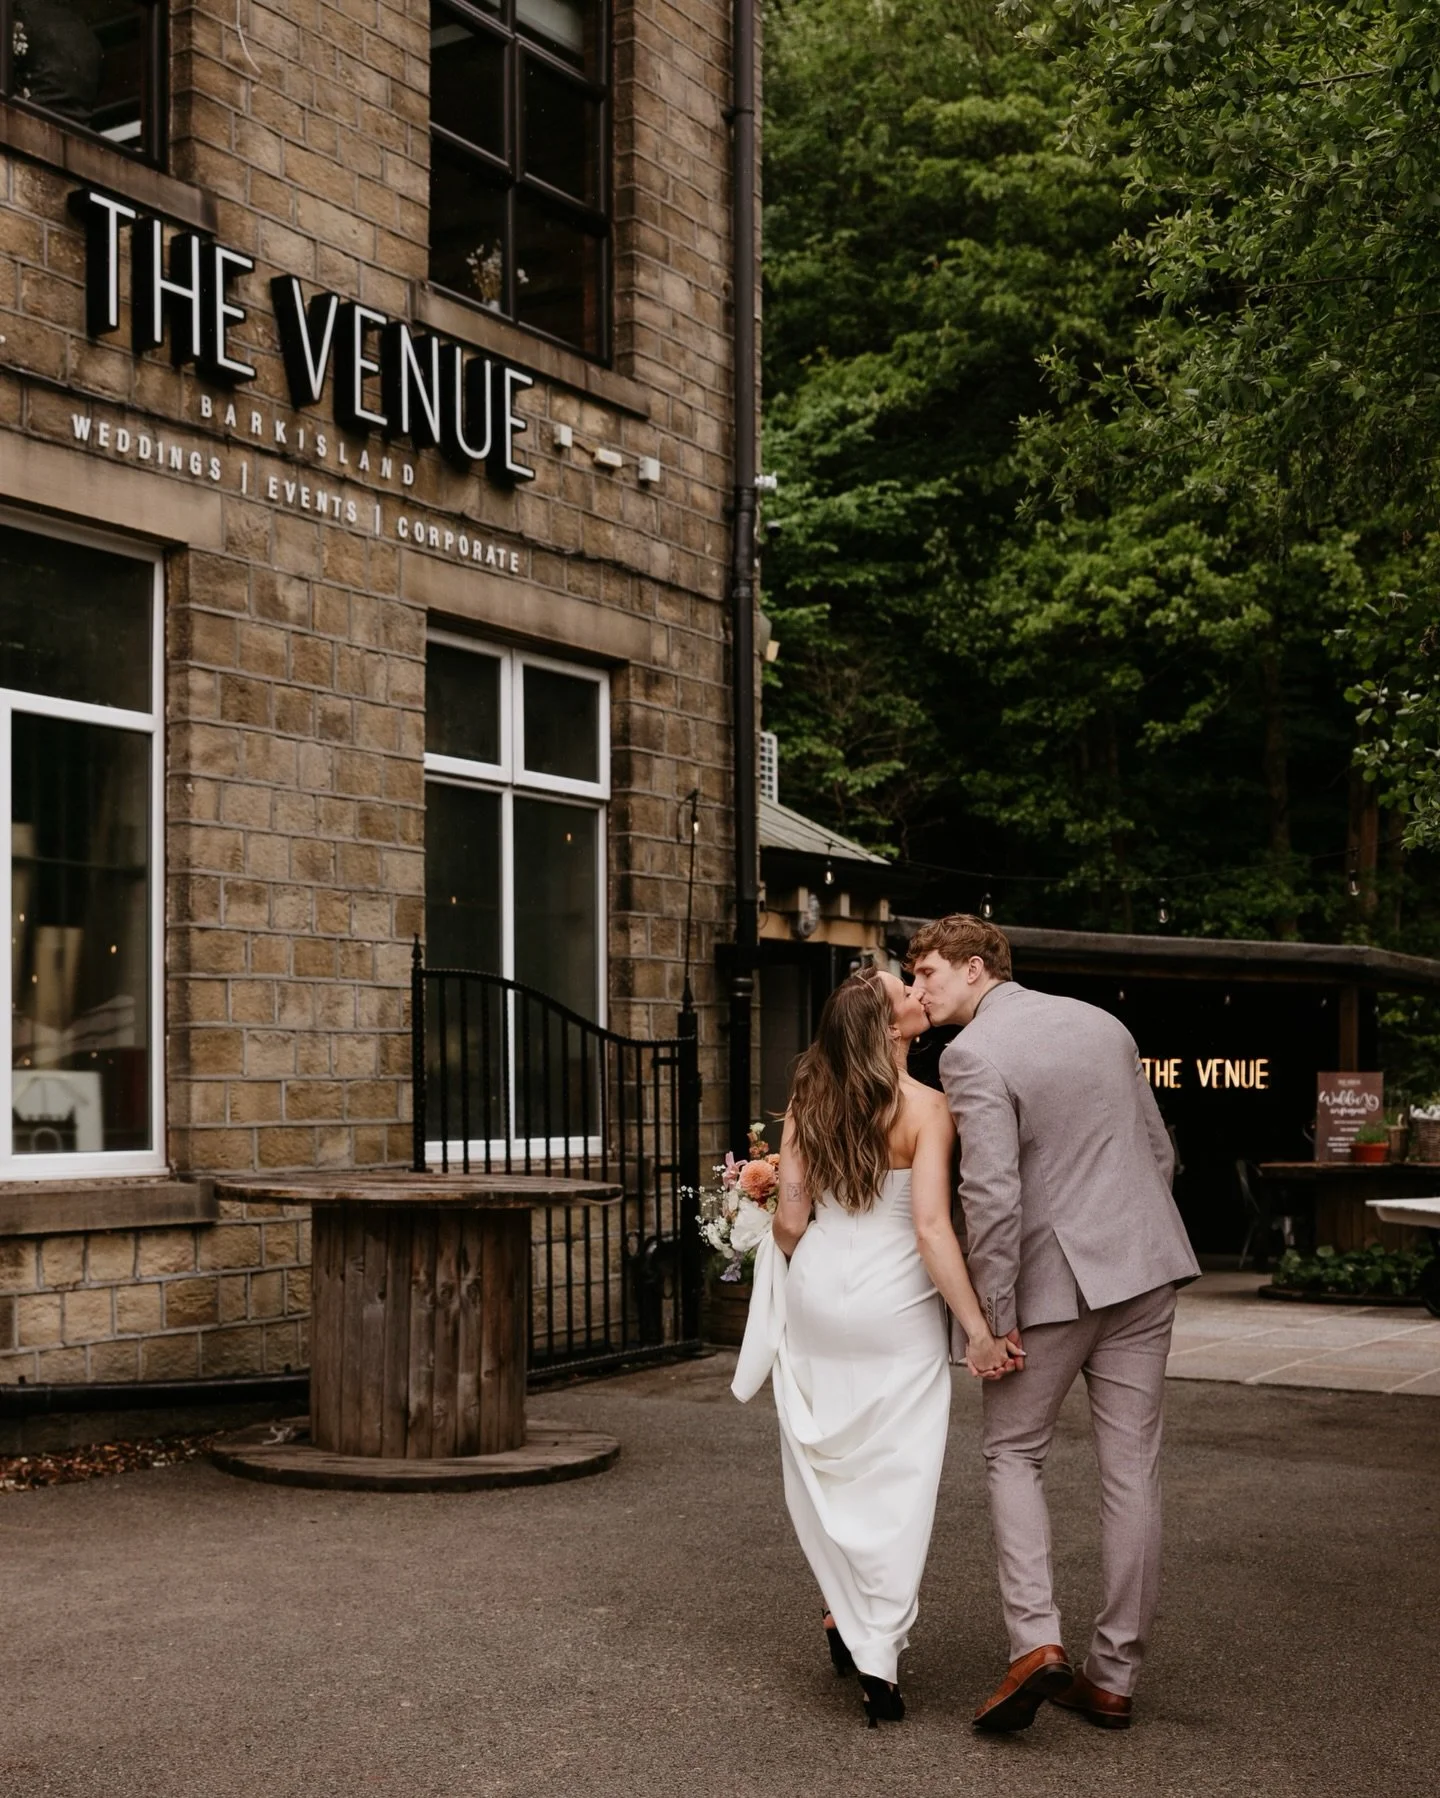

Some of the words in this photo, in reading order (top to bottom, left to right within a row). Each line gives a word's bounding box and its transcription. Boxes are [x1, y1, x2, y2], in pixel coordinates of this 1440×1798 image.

[88, 192, 256, 379] THE
[291, 277, 536, 481] VENUE
[71, 413, 222, 482] WEDDINGS
[267, 475, 358, 524] EVENTS
[397, 516, 521, 573] CORPORATE
[200, 394, 416, 487] BARKISLAND
[1140, 1058, 1182, 1089] THE
[1196, 1058, 1269, 1089] VENUE
